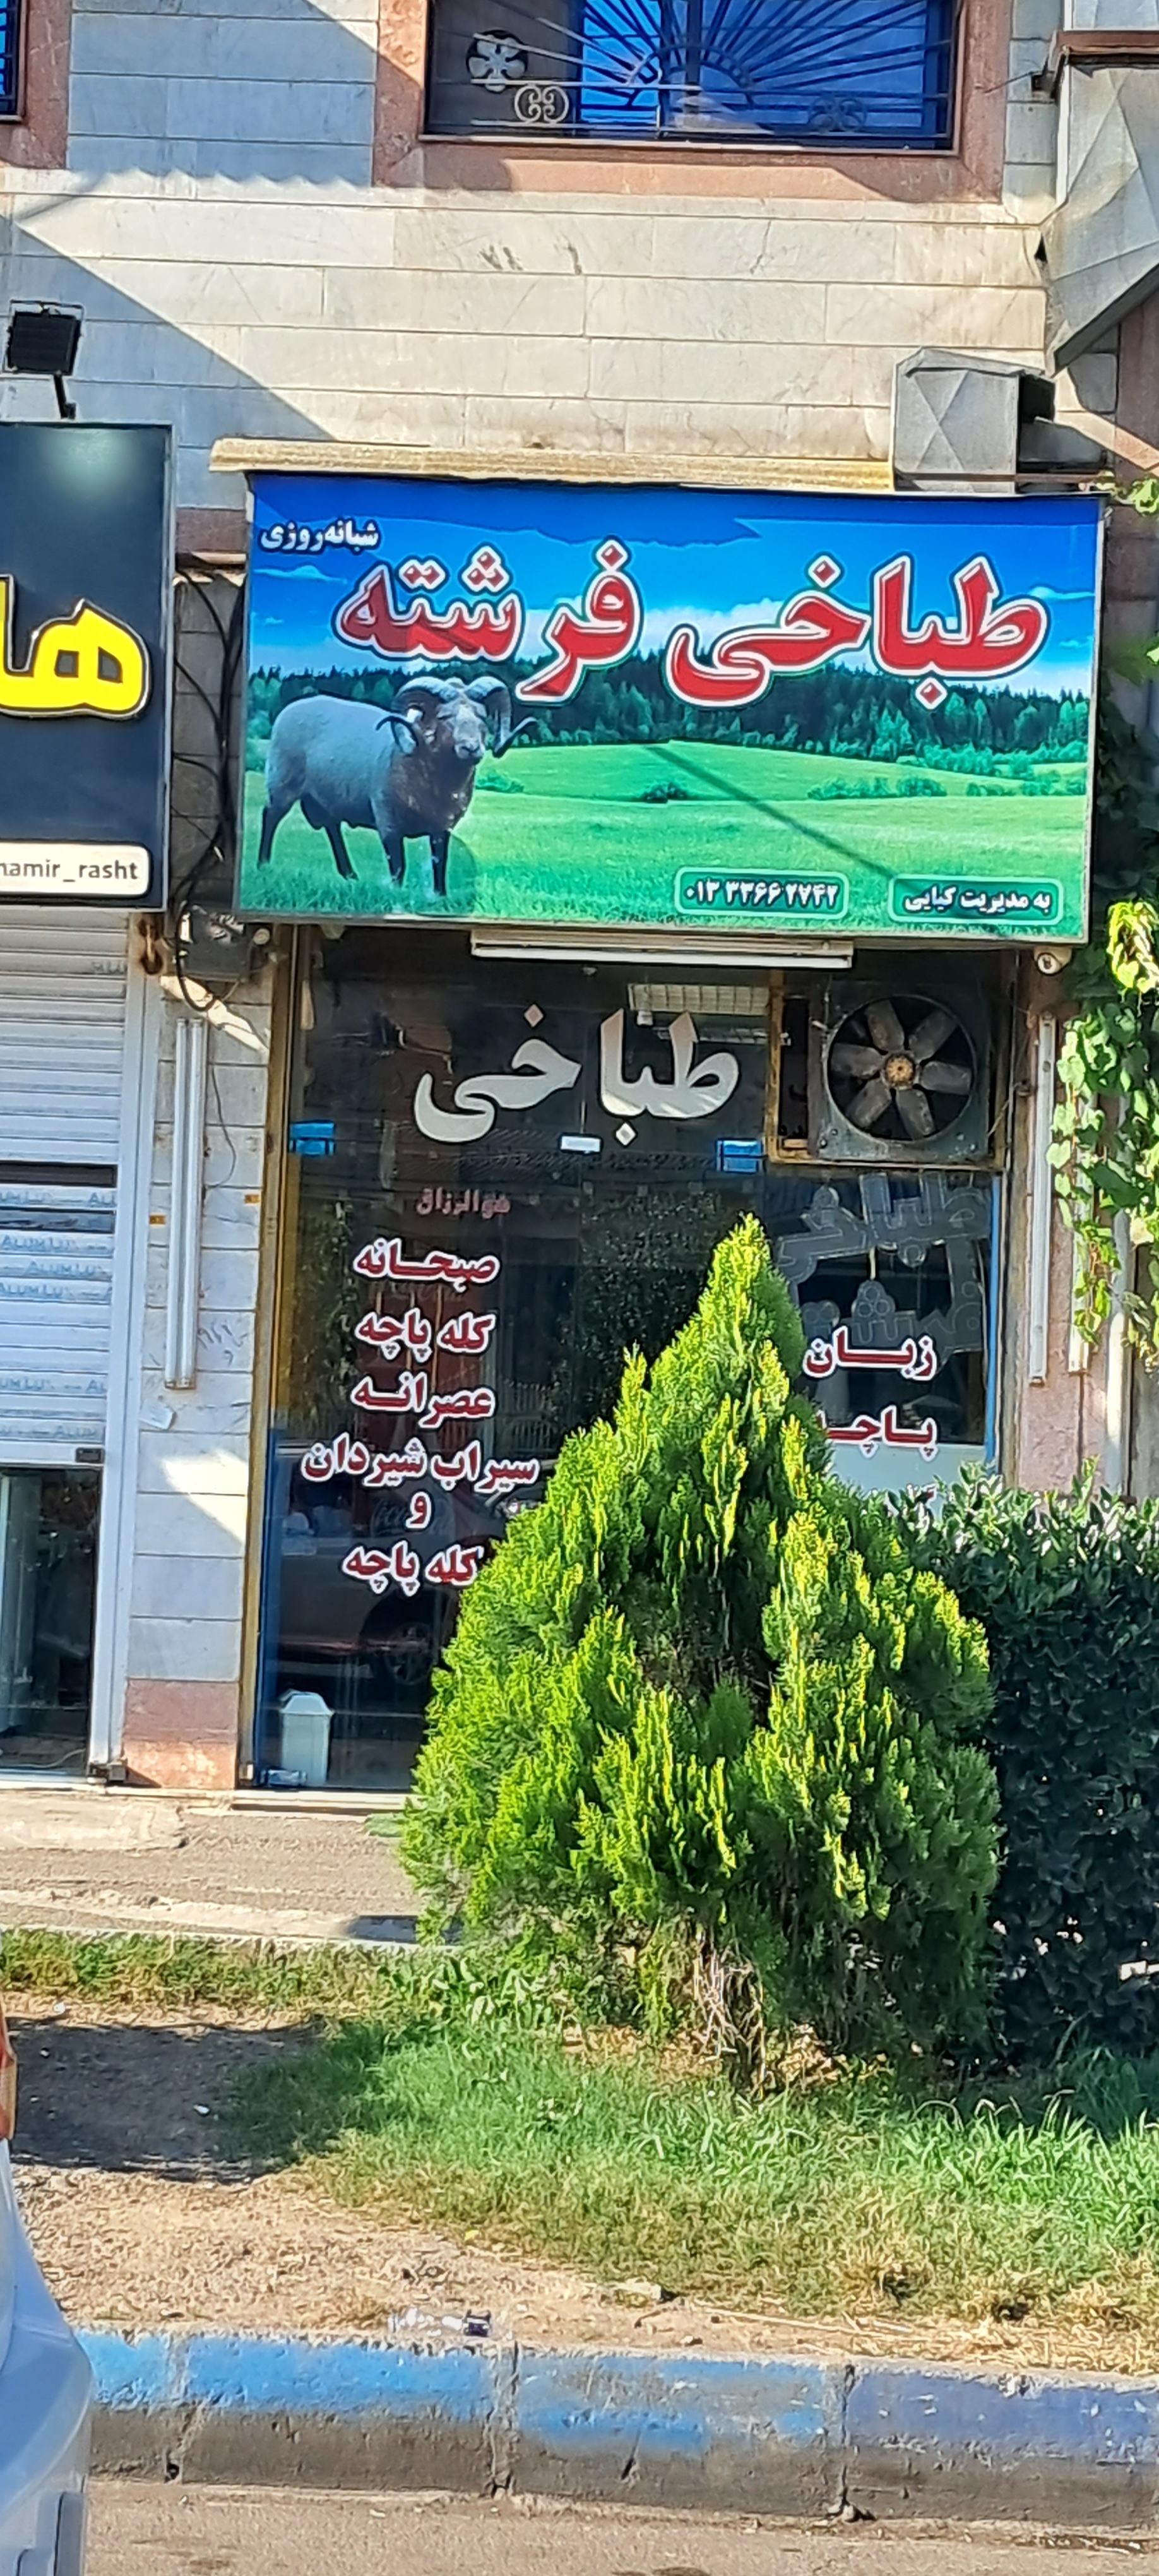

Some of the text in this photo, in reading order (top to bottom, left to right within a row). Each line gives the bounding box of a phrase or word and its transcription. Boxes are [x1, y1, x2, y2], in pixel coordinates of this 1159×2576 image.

[335, 538, 1047, 710] طباخی فرشته
[960, 891, 1030, 914] مدیریت
[1033, 892, 1051, 913] به
[414, 1004, 739, 1146] طباخی
[354, 1237, 500, 1292] صبحانه
[355, 1308, 496, 1363] کله پاچه
[802, 1326, 937, 1380] زبان
[351, 1371, 496, 1428] عصرانه
[302, 1433, 540, 1493] سیراب شیردان
[406, 1491, 432, 1529] و
[342, 1541, 484, 1597] کله پاچه
